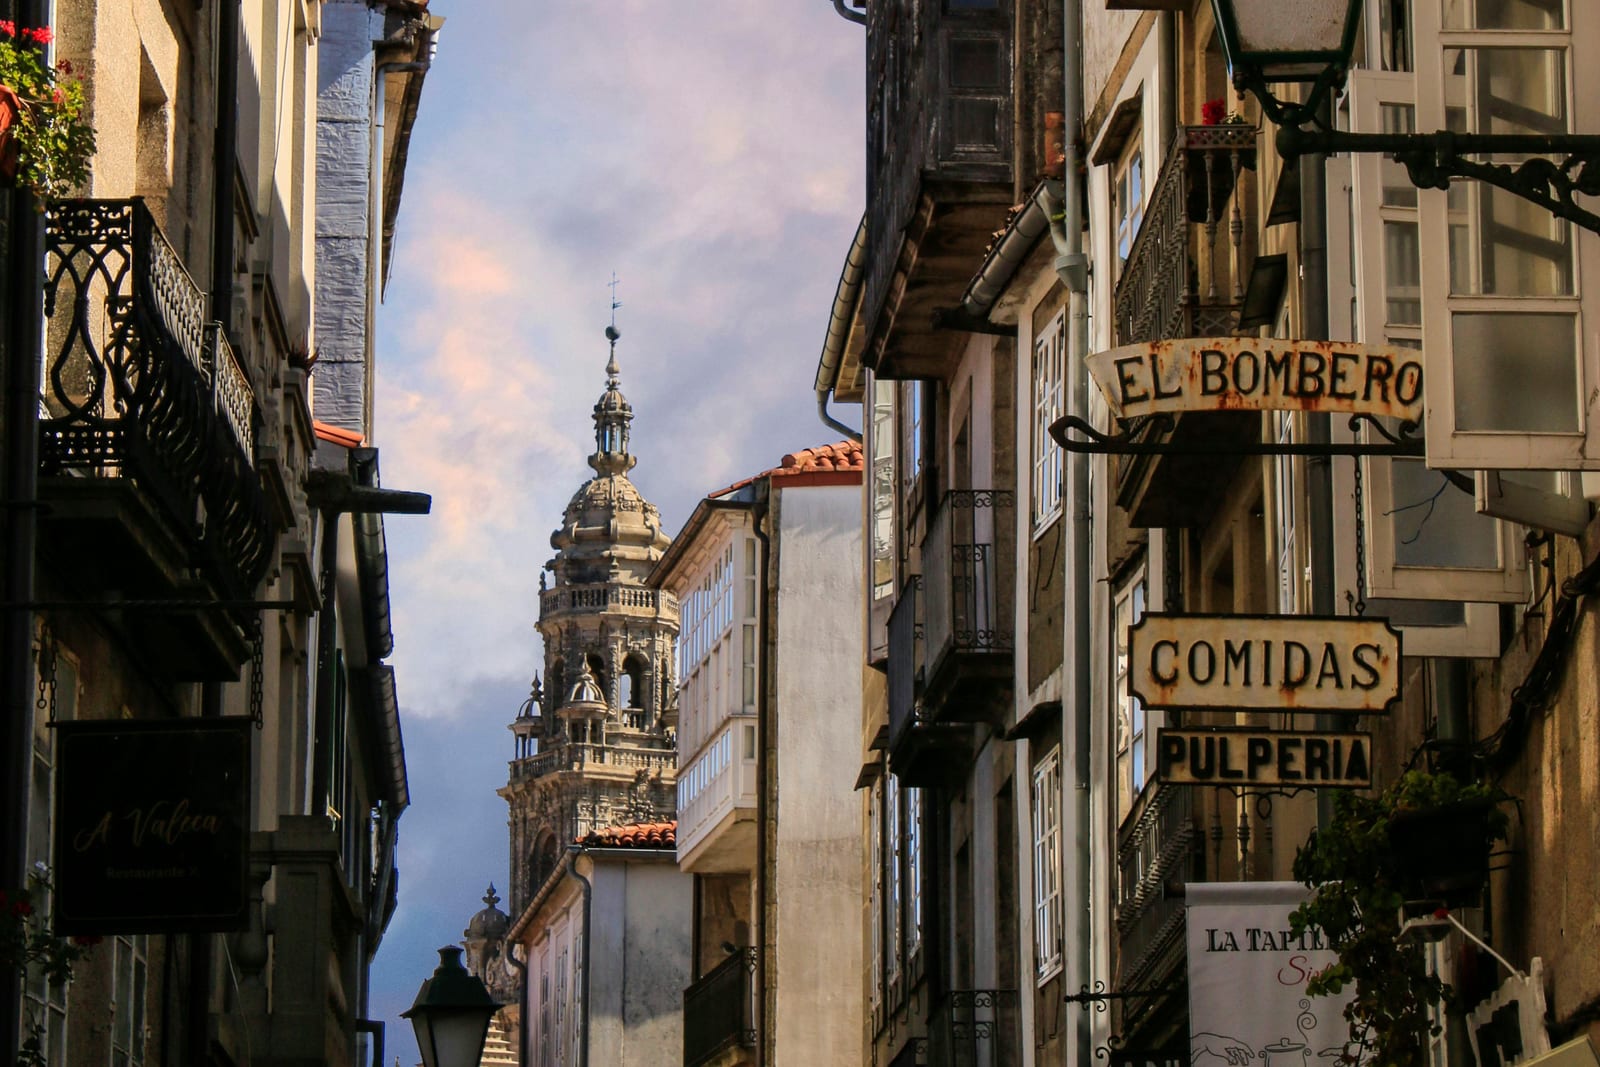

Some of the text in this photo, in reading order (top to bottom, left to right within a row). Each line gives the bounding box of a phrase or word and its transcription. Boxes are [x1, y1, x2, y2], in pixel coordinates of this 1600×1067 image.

[1114, 349, 1424, 405] EL BOMBERO
[1150, 639, 1381, 690] COMIDAS
[1161, 735, 1369, 780] PULPERIA
[1205, 928, 1241, 952] LA
